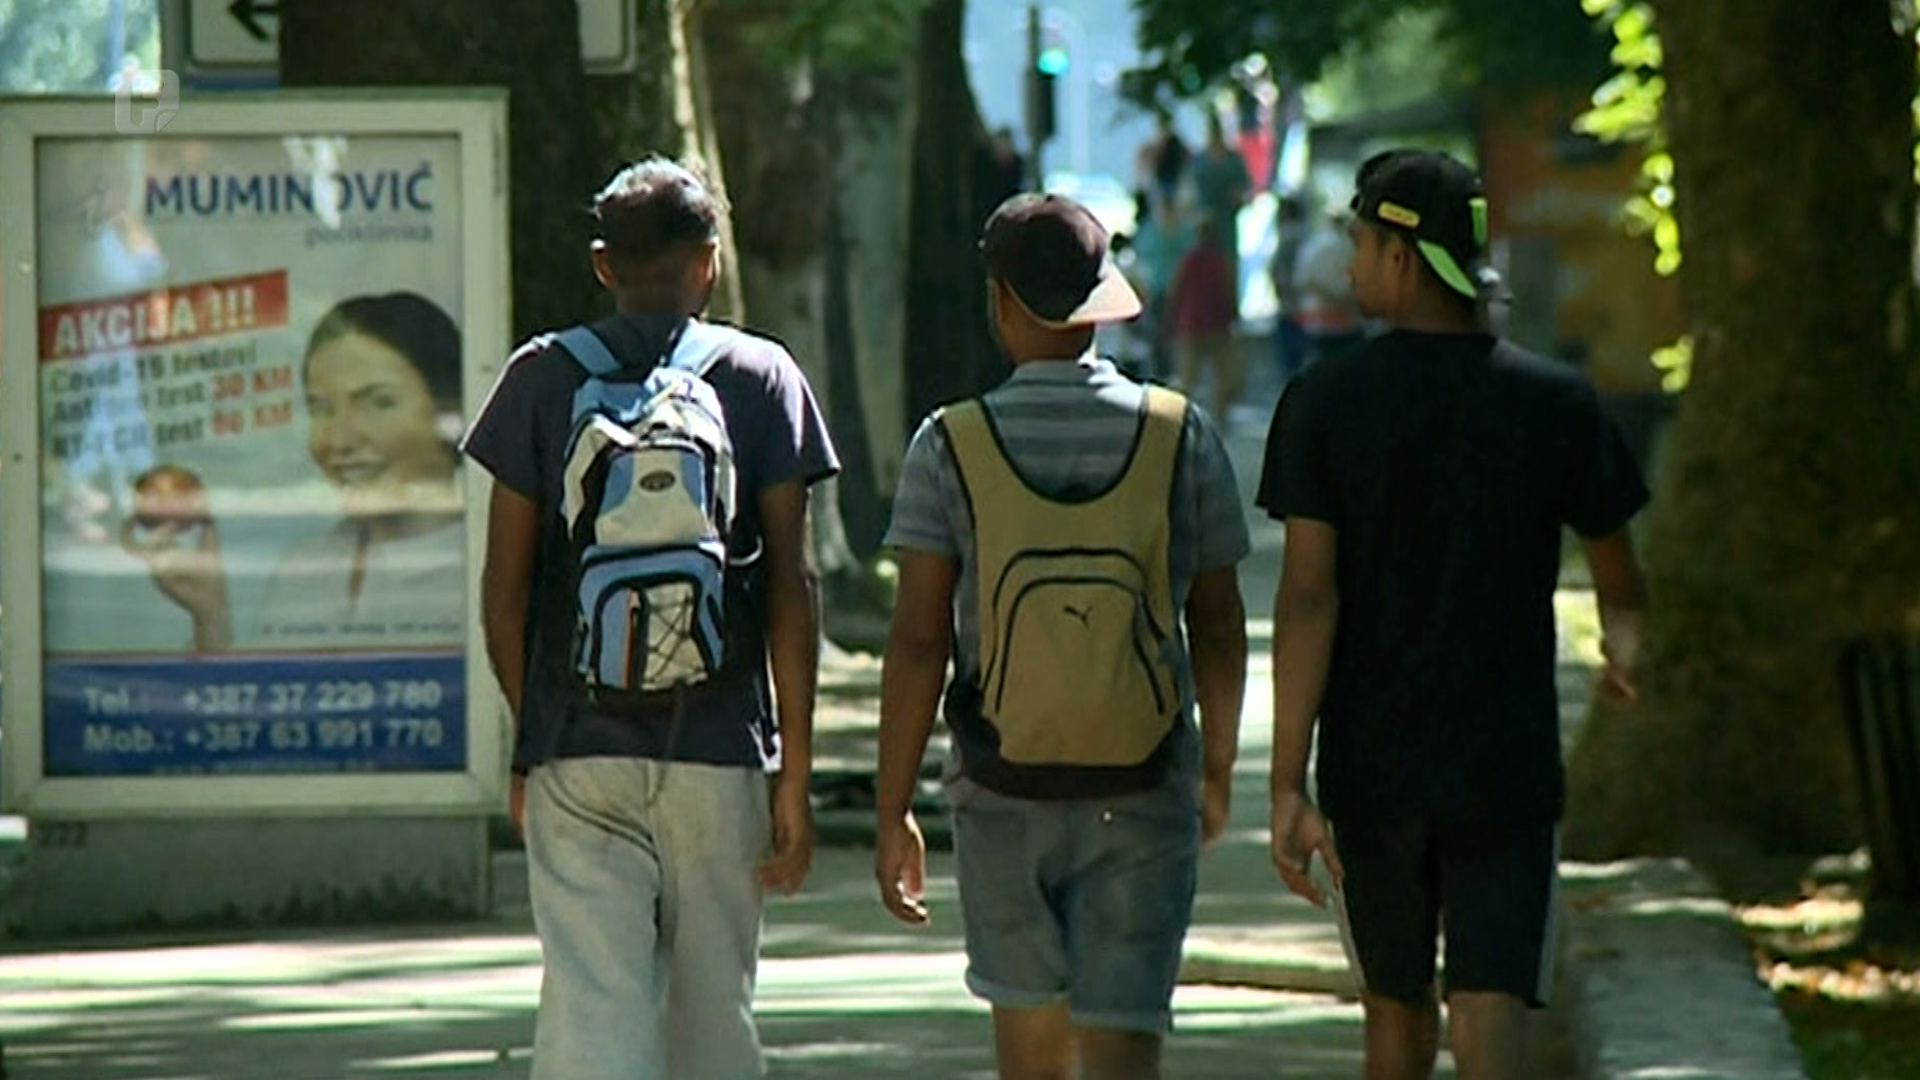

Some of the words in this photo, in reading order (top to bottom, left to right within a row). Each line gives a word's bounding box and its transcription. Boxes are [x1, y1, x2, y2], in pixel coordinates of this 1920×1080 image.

[146, 161, 433, 214] MUMINOVIĆ
[53, 295, 197, 357] AKCIJA
[254, 362, 293, 393] KM
[254, 400, 293, 429] KM
[184, 683, 259, 713] +387
[269, 683, 307, 712] 37
[316, 681, 375, 711] 229
[184, 720, 260, 749] +387
[269, 720, 308, 749] 63
[317, 718, 373, 748] 991
[384, 717, 443, 747] 770
